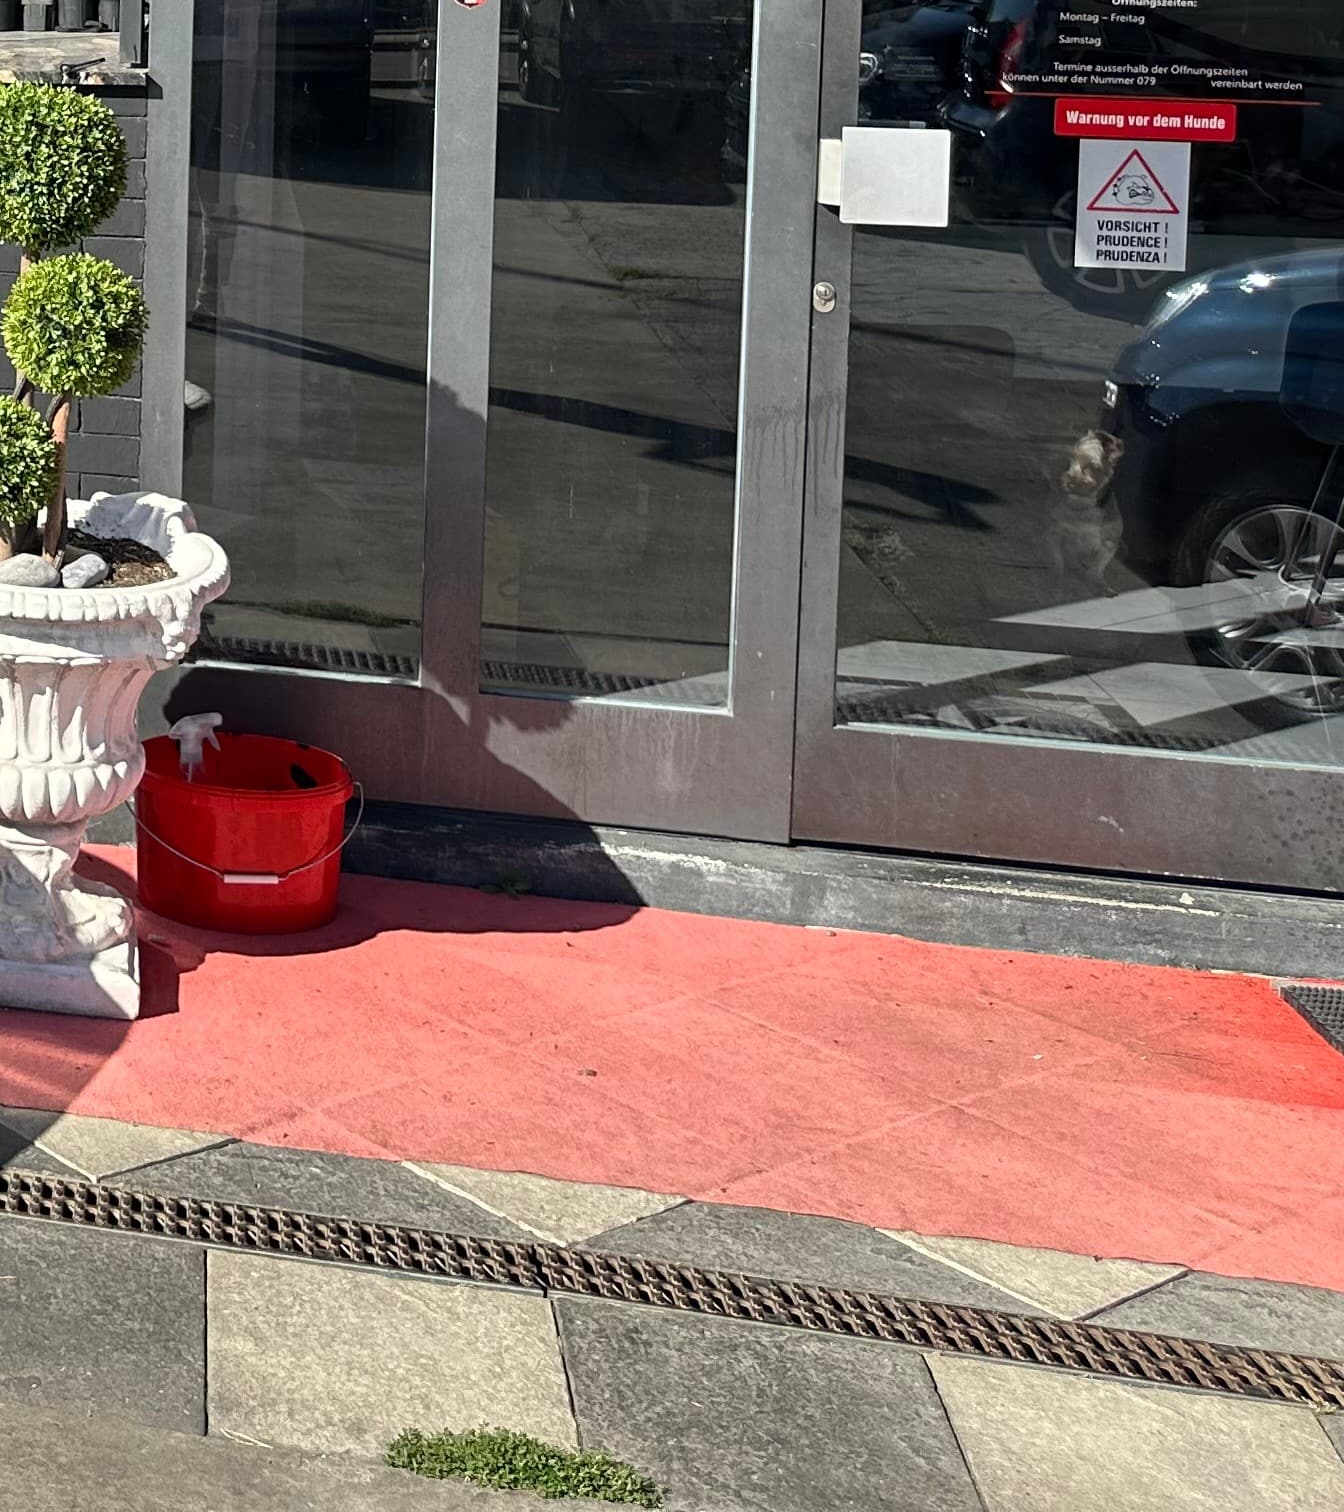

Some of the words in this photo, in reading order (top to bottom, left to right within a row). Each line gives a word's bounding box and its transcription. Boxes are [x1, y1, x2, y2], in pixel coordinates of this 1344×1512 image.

[1059, 11, 1100, 24] Montag
[1110, 13, 1145, 25] Freitag
[1059, 35, 1102, 47] Samstag
[1053, 62, 1093, 73] Termine
[1095, 63, 1149, 74] ausserhalb
[1151, 64, 1169, 75] der
[1171, 64, 1248, 77] Öffnungszeiten
[1002, 72, 1040, 84] können
[1041, 74, 1068, 84] unter
[1070, 74, 1088, 85] der
[1090, 76, 1135, 86] Nummer
[1136, 76, 1156, 86] 079
[1210, 80, 1263, 90] vereinbart
[1264, 81, 1303, 90] werden
[1066, 110, 1124, 128] Warnung
[1128, 114, 1150, 127] vor
[1153, 114, 1181, 128] dem
[1184, 114, 1226, 130] Hunde
[1096, 219, 1160, 233] VORSICHT
[1096, 234, 1161, 248] PRUDENCE
[1096, 250, 1160, 263] PRUDENZA
